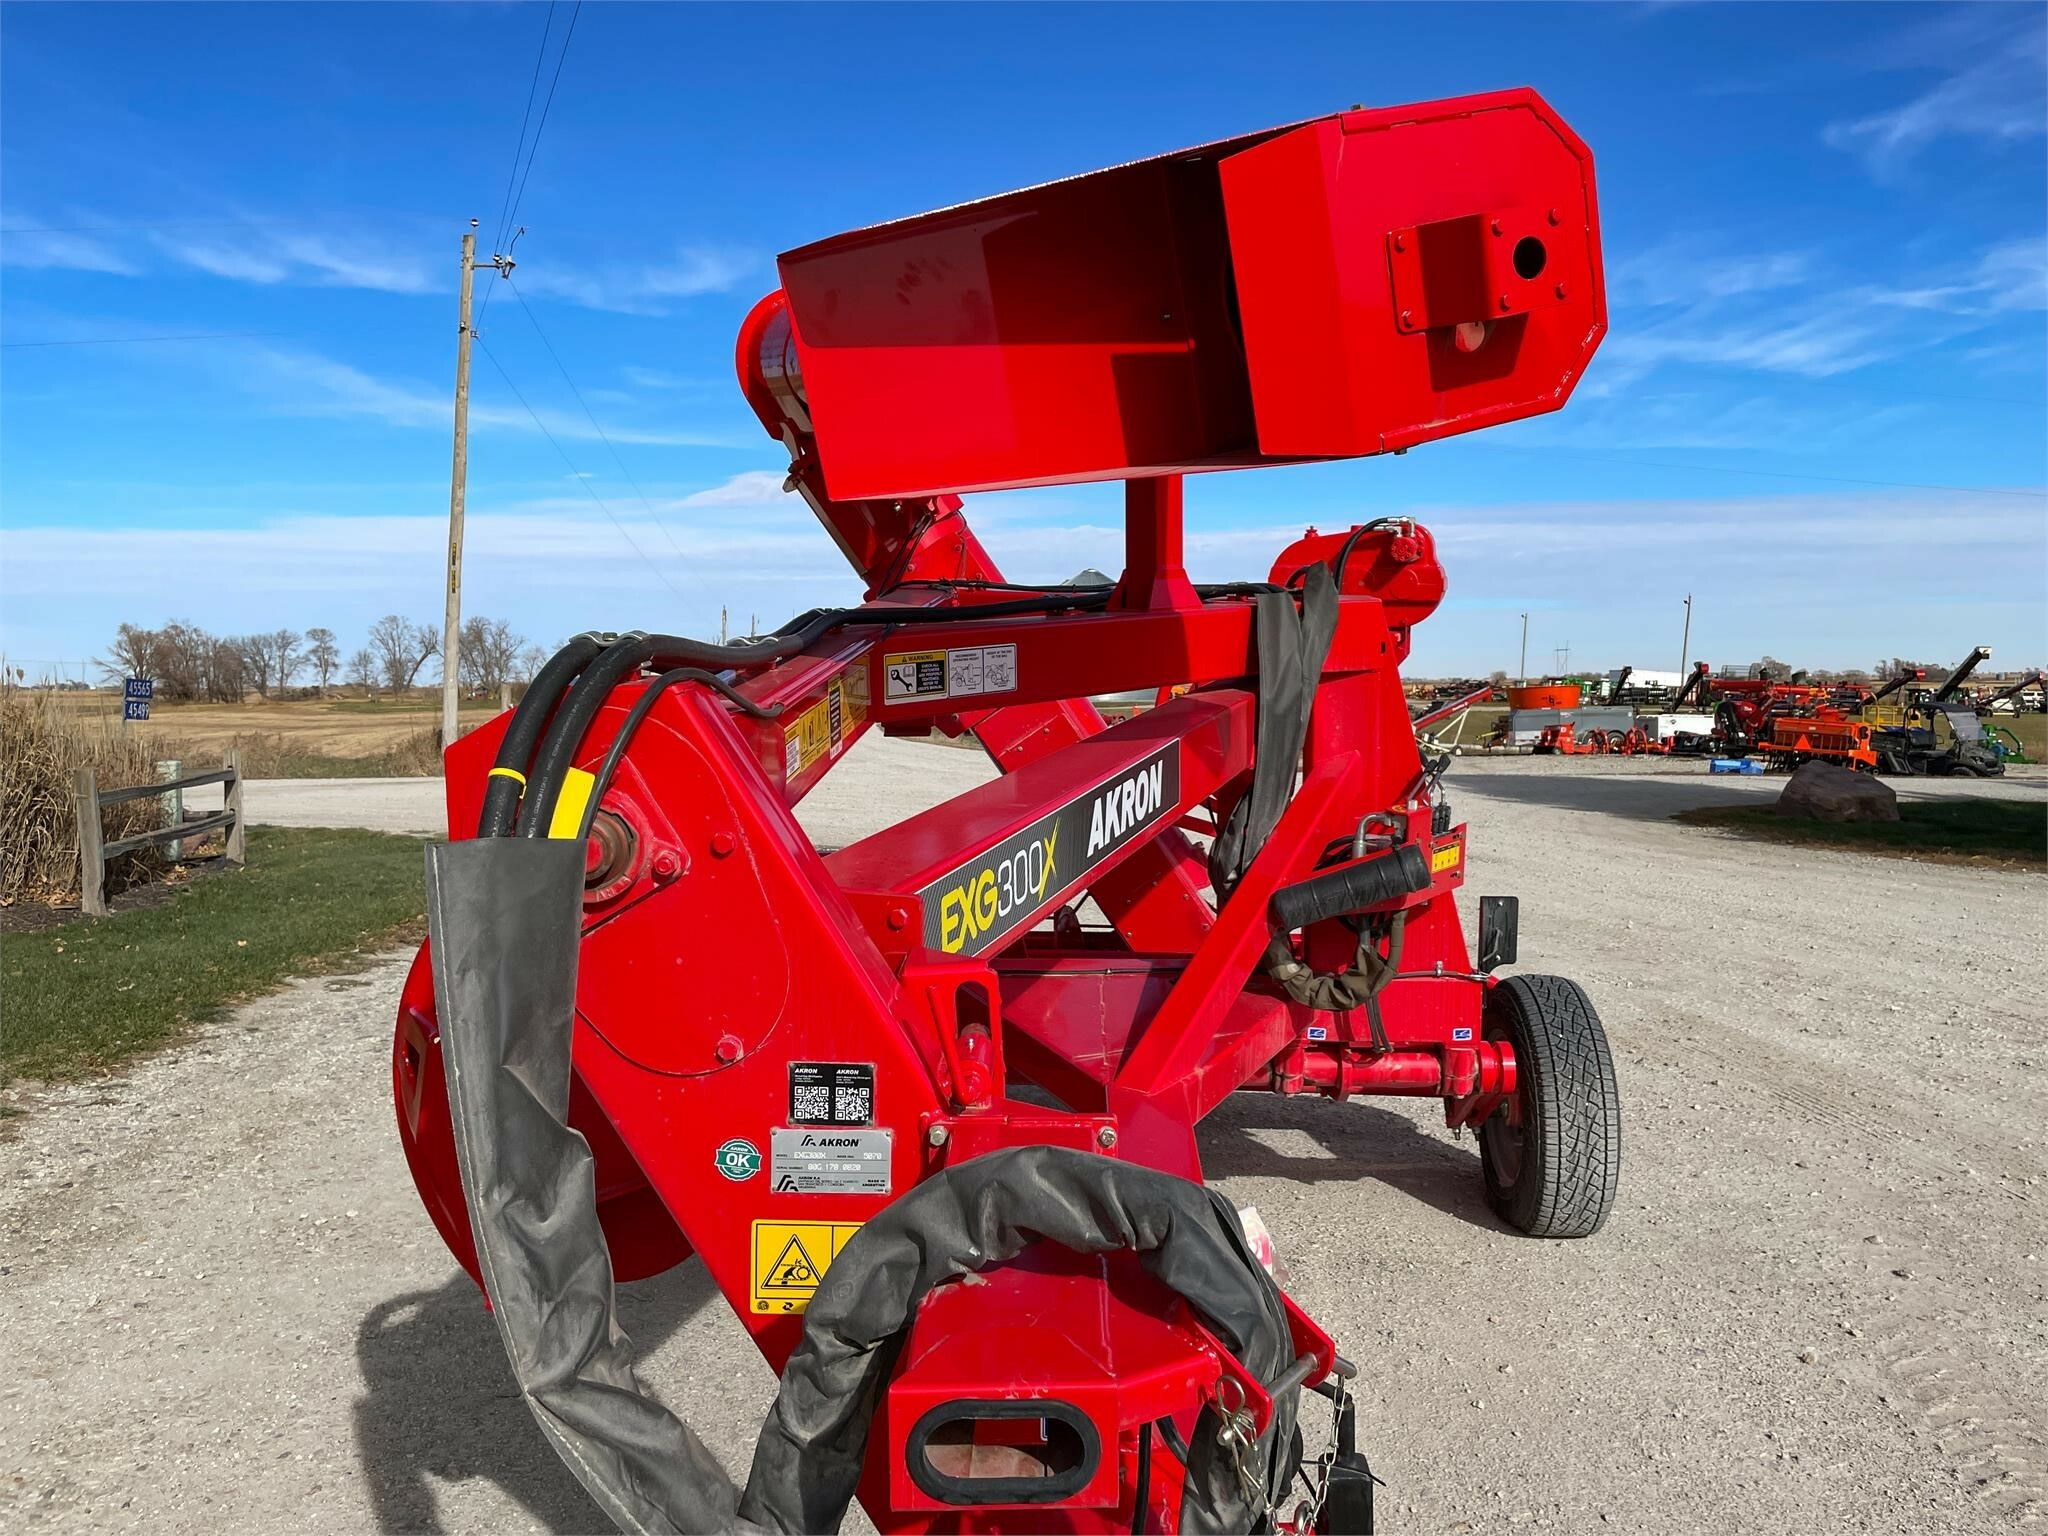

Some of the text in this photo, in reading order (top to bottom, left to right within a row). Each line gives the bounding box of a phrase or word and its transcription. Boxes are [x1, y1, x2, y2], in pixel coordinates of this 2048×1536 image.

[908, 654, 934, 662] WARNING
[129, 682, 150, 696] 45565
[128, 703, 149, 718] 45499
[1087, 759, 1164, 858] AKRON
[940, 816, 1061, 954] EXG300X
[818, 1138, 861, 1148] AKRON
[726, 1153, 751, 1167] OK
